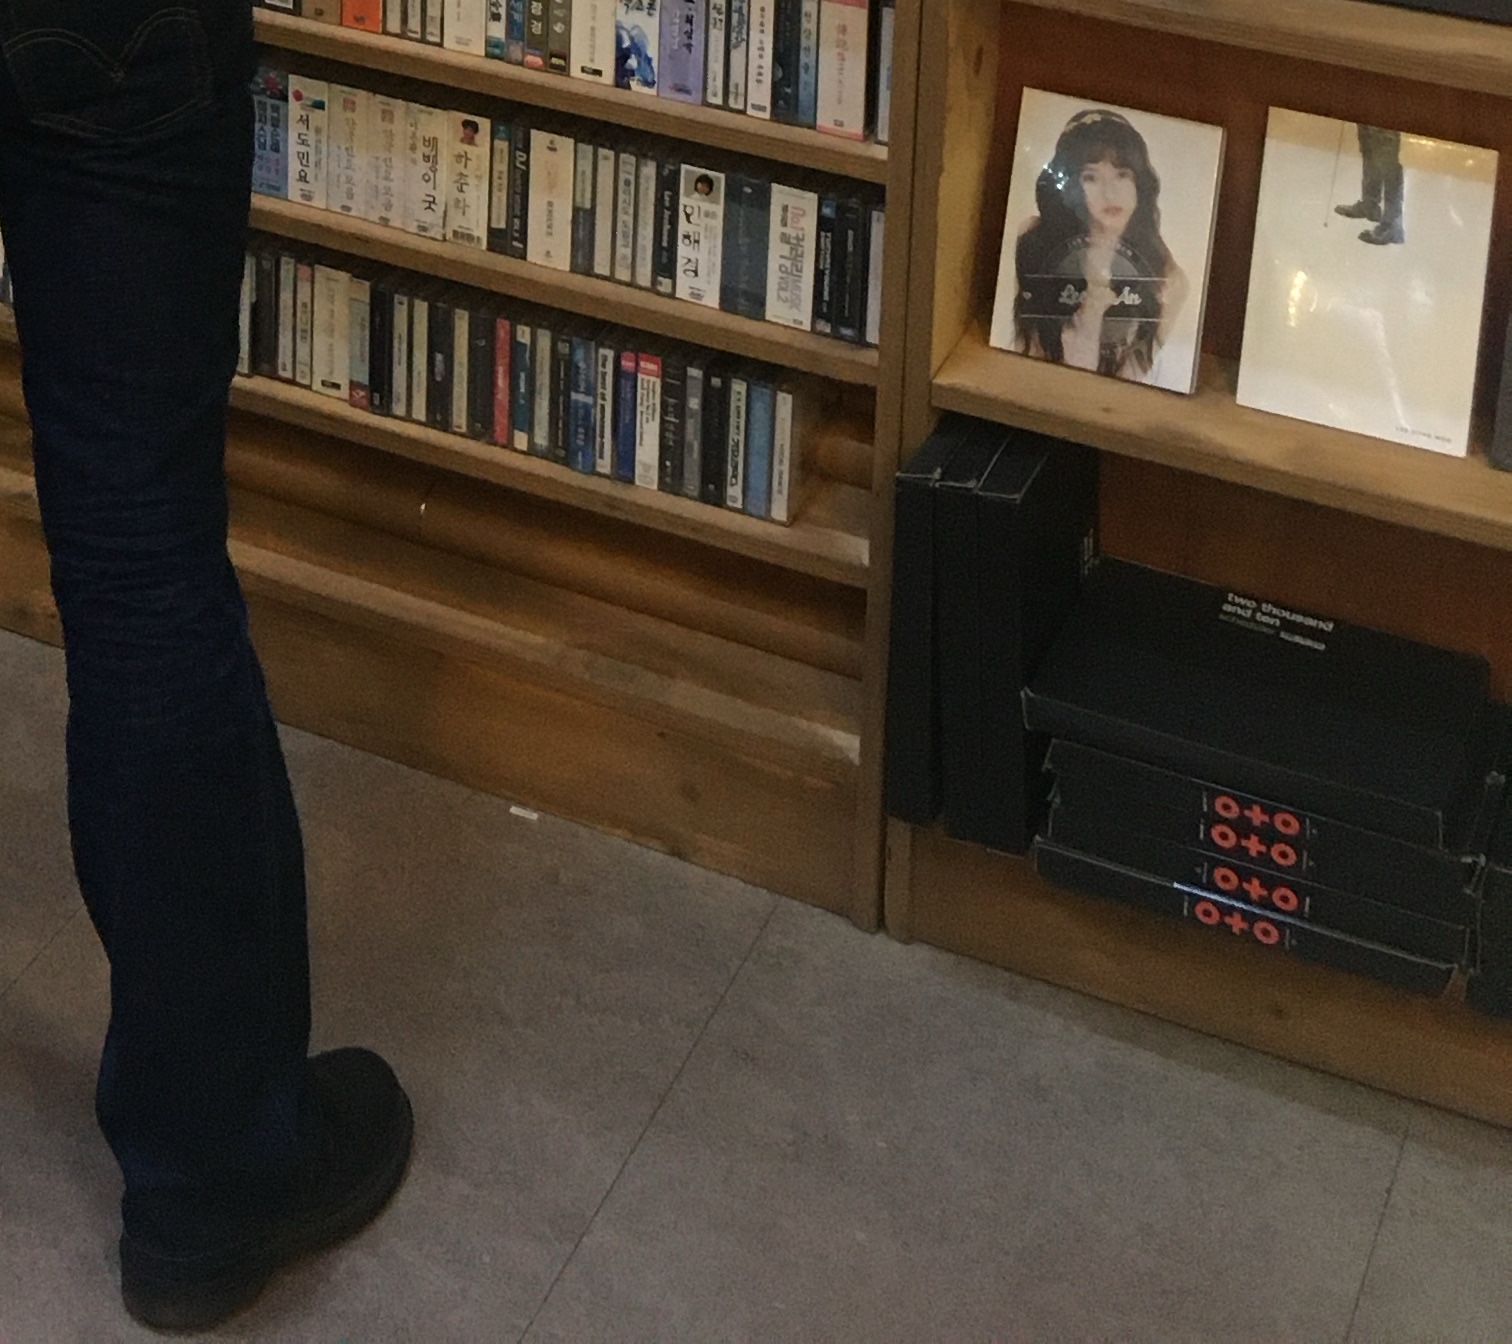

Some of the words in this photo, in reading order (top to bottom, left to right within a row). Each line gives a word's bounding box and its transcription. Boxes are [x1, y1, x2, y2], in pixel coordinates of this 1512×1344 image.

[295, 114, 311, 184] 서도민요
[681, 202, 702, 280] 민해경
[1221, 602, 1250, 619] and
[1254, 608, 1282, 627] ten
[1227, 592, 1256, 611] two
[1261, 600, 1335, 634] thousand
